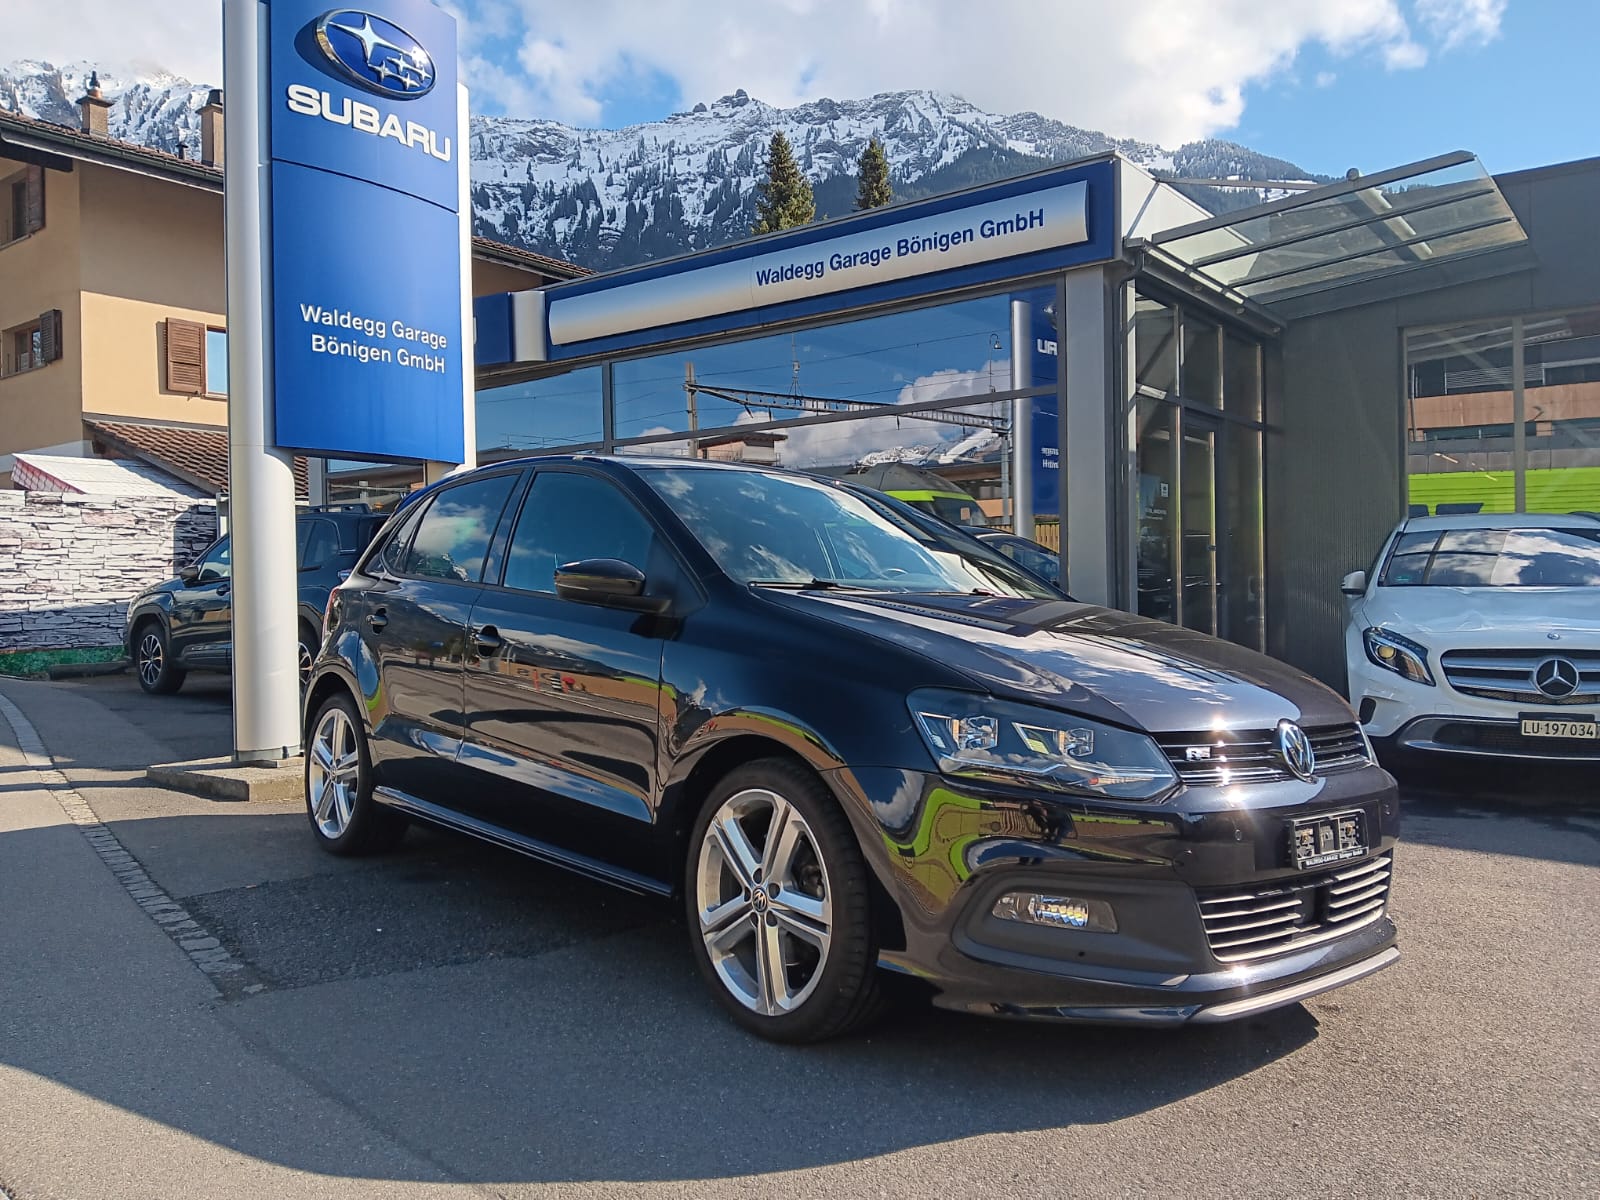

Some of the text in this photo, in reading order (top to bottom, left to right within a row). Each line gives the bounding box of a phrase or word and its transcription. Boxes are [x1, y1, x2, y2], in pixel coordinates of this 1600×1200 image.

[287, 84, 451, 162] SUBARU
[756, 208, 1044, 286] Waldegg Garage Bönigen GmbH
[300, 303, 447, 350] Waldegg Garage
[311, 334, 445, 373] Bönigen GmbH
